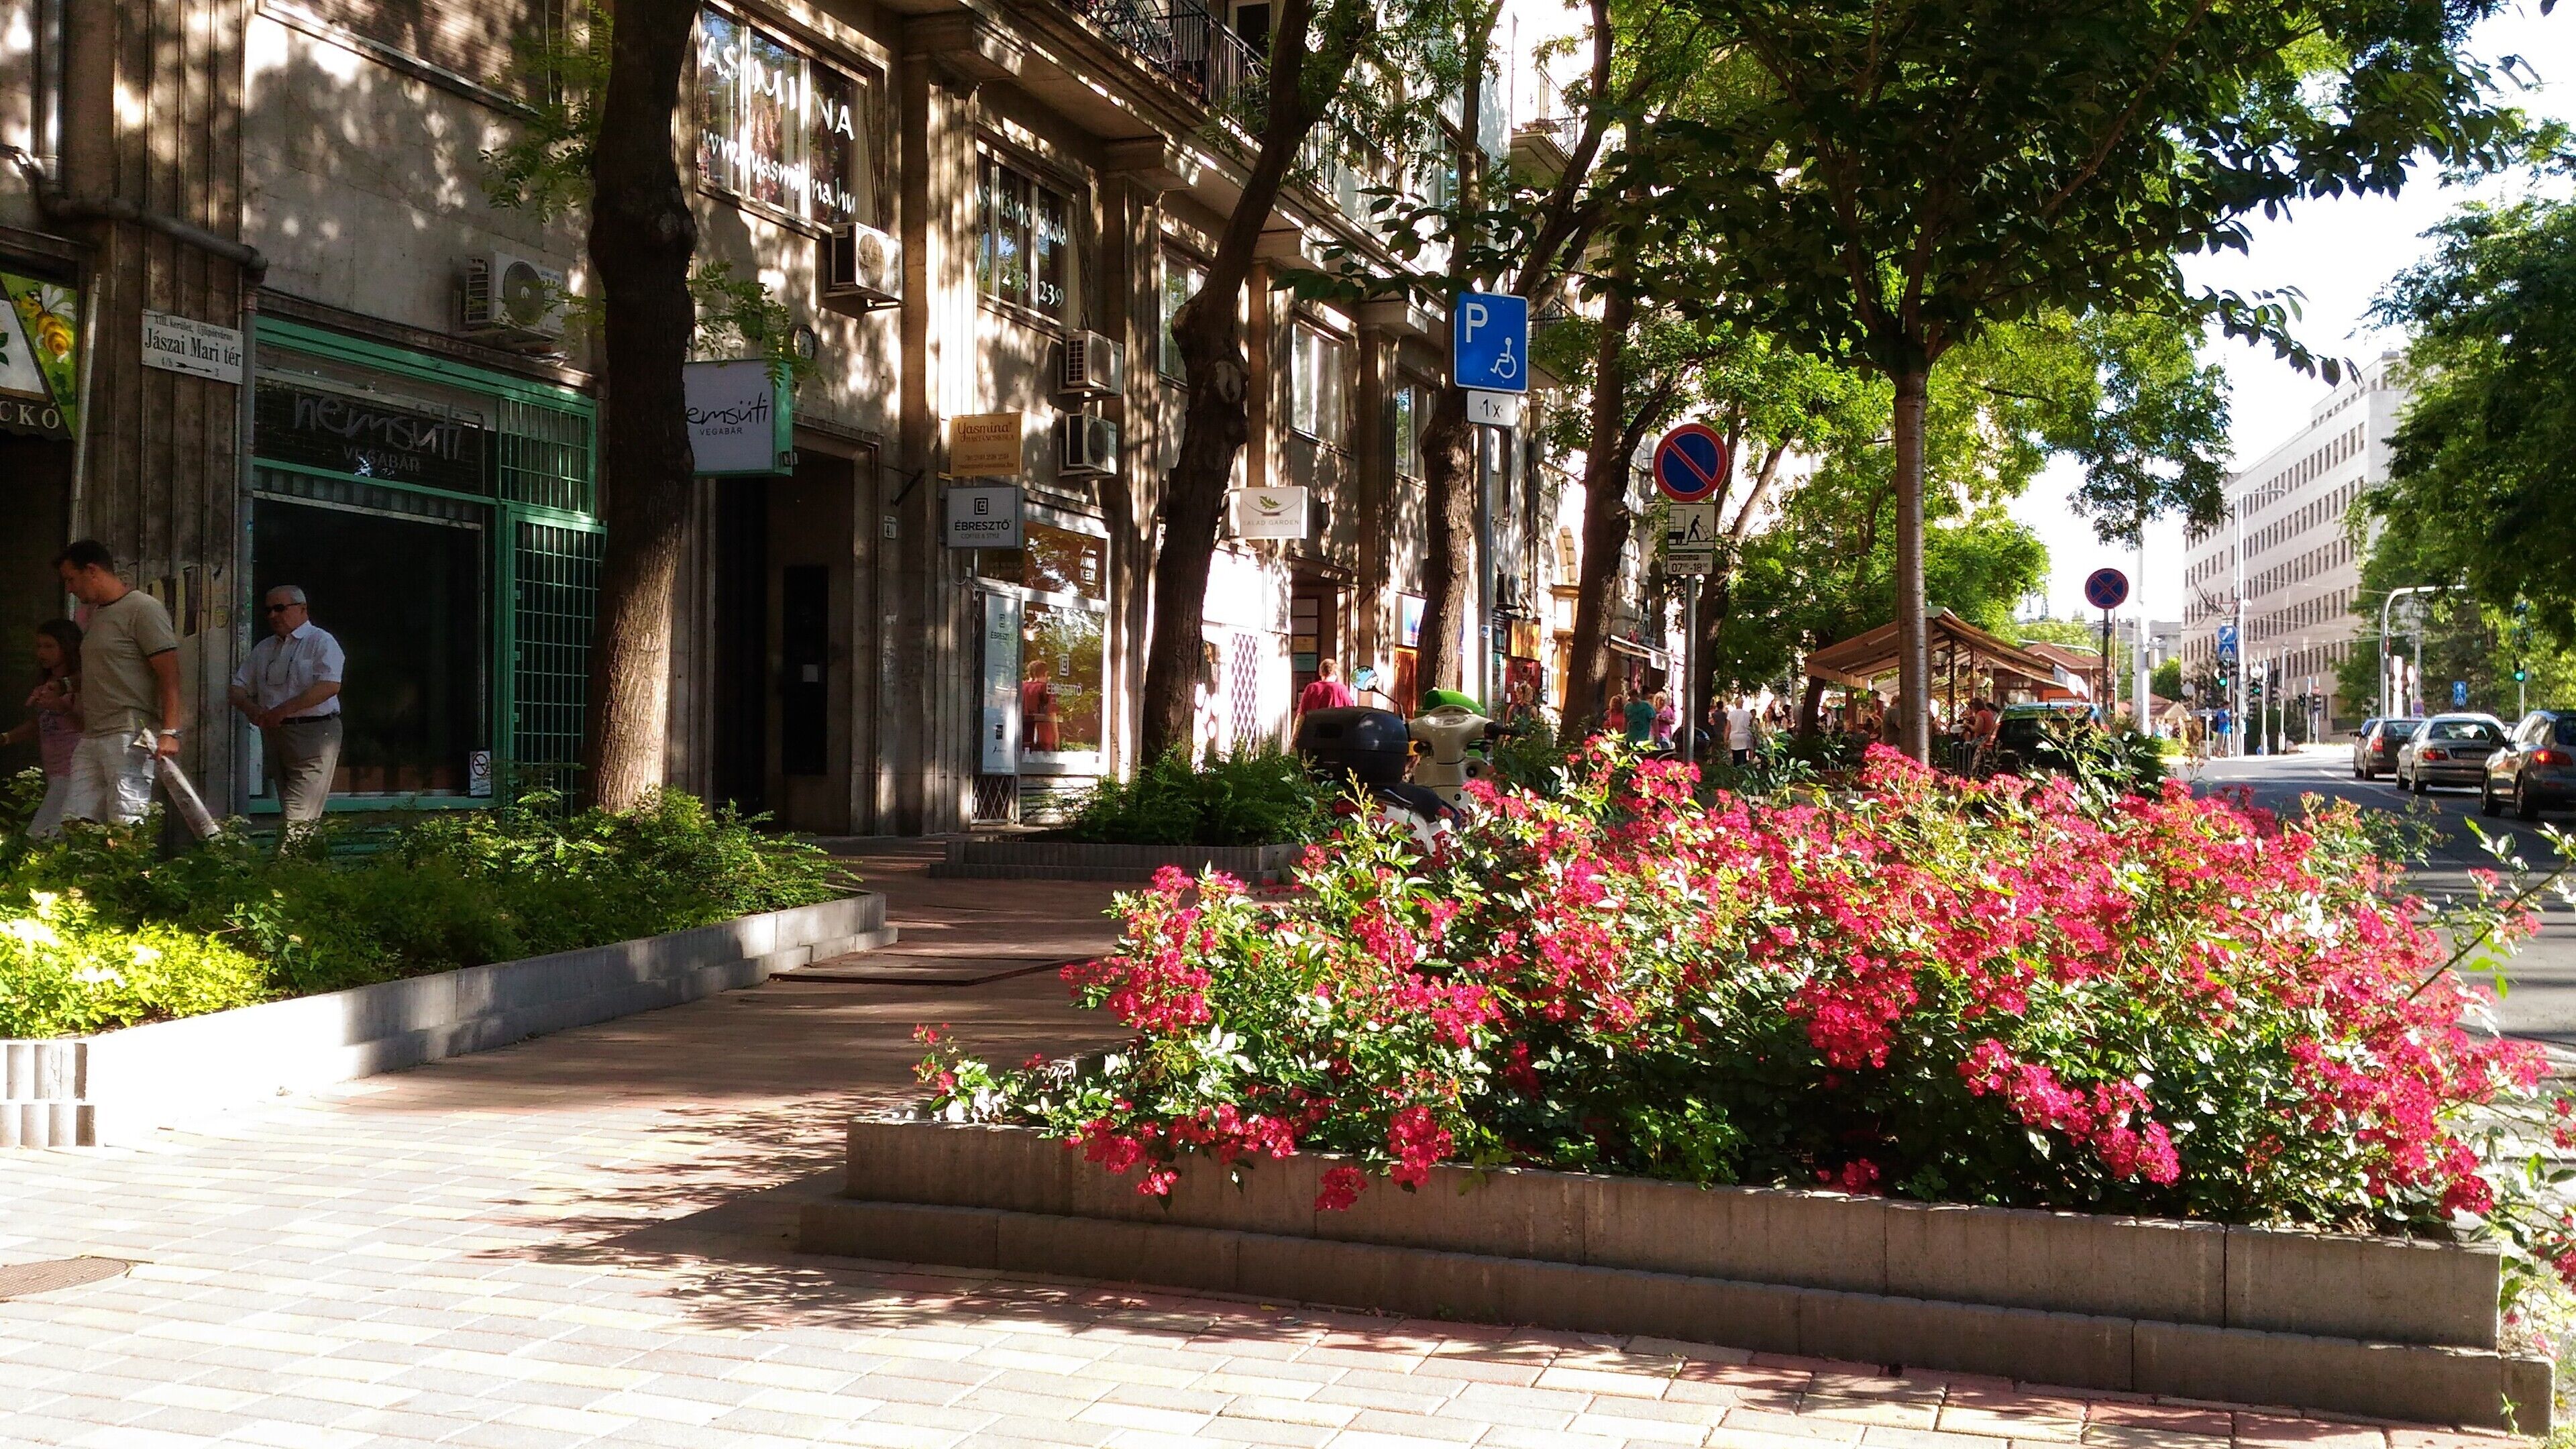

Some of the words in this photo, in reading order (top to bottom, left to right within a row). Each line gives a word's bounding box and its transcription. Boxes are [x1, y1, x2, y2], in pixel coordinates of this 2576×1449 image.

[701, 32, 855, 141] ASMINA
[1466, 303, 1488, 343] P
[145, 328, 184, 355] Jászai
[191, 337, 219, 362] Mari
[223, 345, 241, 366] tér
[0, 400, 60, 429] CKÓ
[686, 392, 768, 425] emsüti
[700, 426, 743, 435] VEGABÁR
[958, 421, 1010, 442] Yasmina
[343, 445, 421, 473] VEGABÁR
[955, 519, 1010, 531] ÉBRESZTŐ
